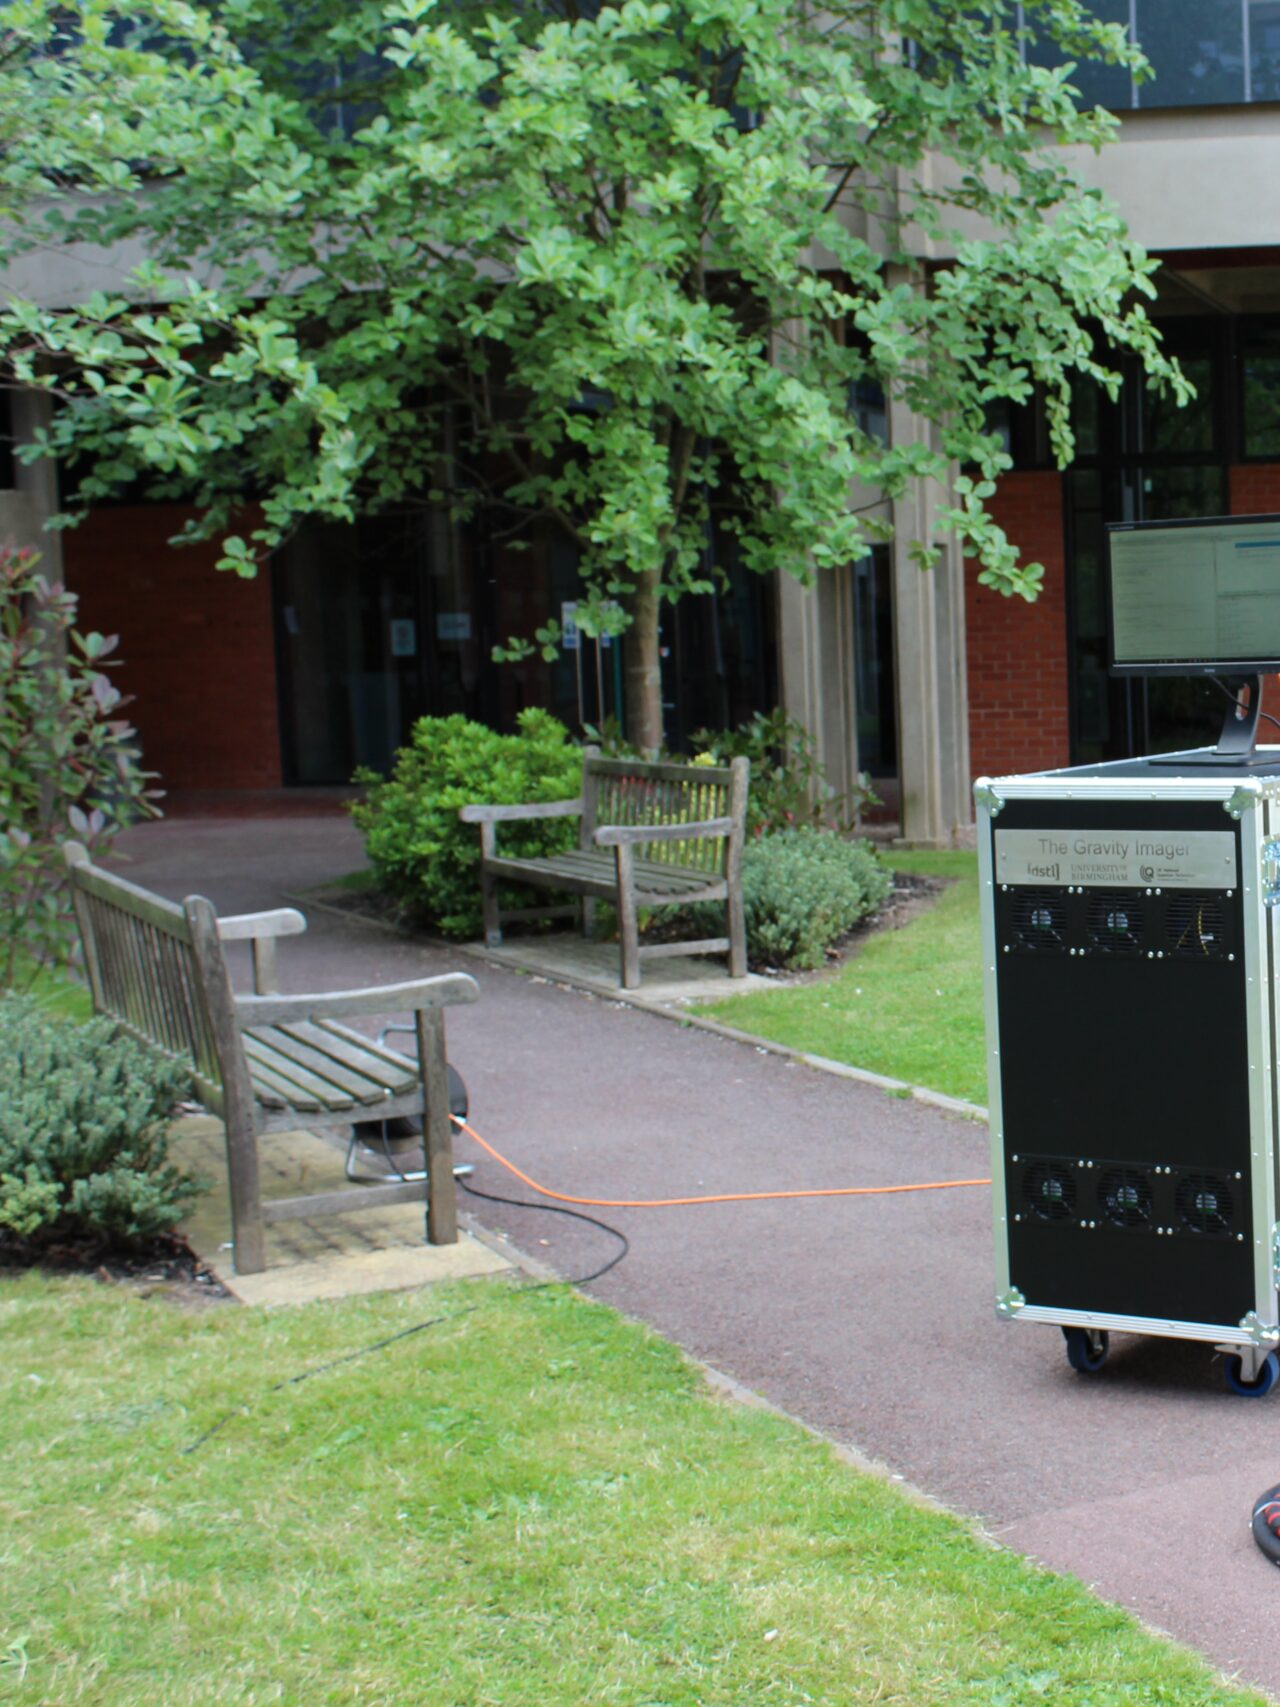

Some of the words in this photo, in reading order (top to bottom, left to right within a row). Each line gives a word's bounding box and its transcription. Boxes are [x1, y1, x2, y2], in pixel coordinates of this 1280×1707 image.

[1038, 839, 1068, 855] The
[1073, 839, 1129, 859] Gravity
[1135, 839, 1191, 860] Imager
[1071, 863, 1119, 873] UNIVERSITY
[1071, 872, 1128, 881] BIRMINGHAM
